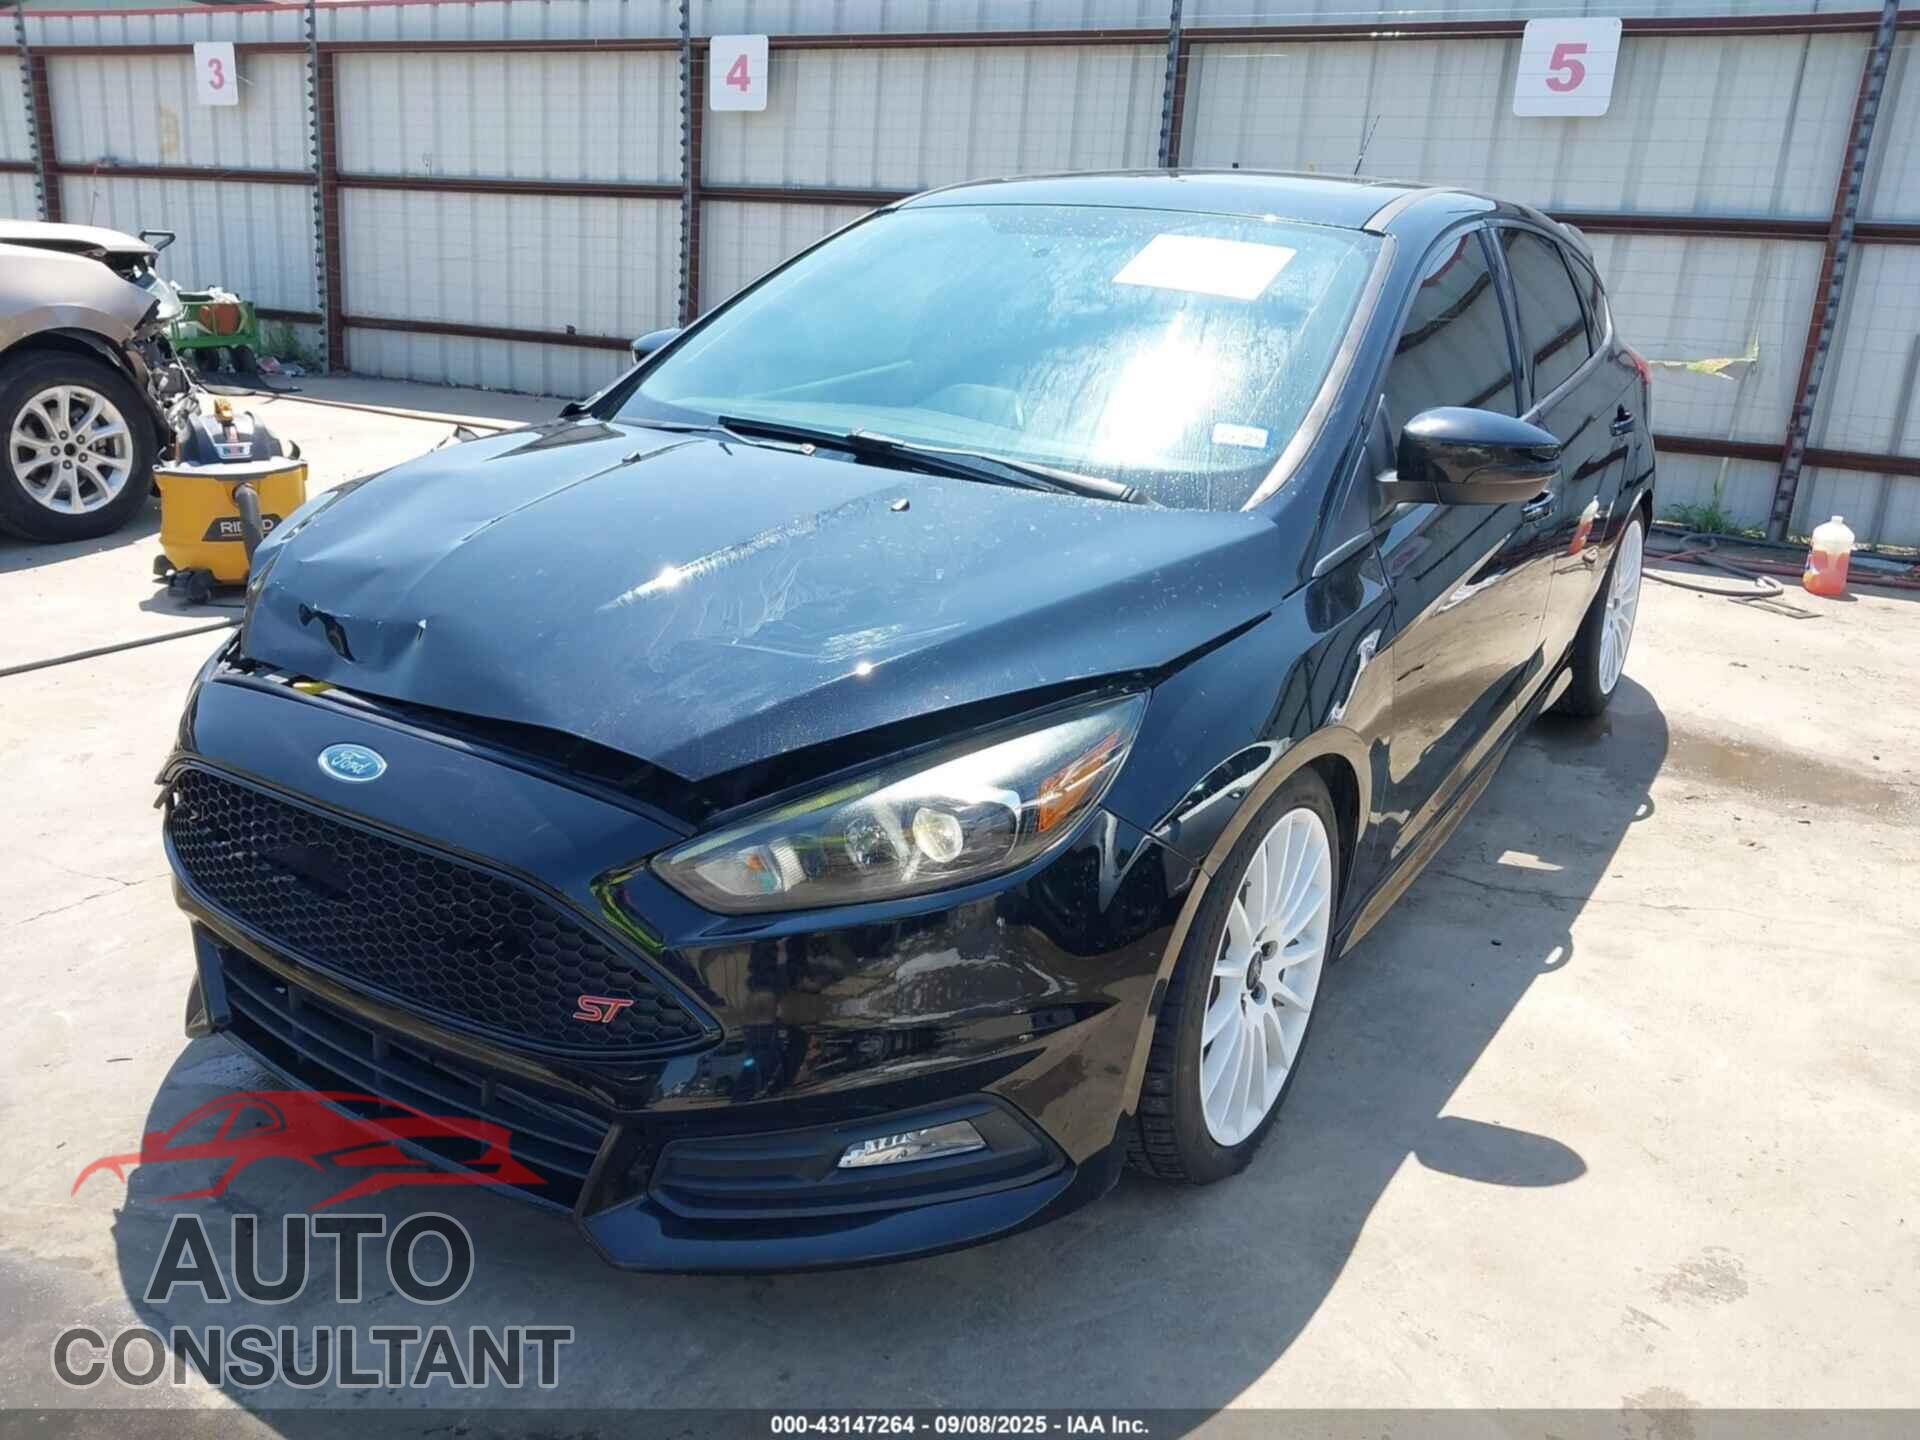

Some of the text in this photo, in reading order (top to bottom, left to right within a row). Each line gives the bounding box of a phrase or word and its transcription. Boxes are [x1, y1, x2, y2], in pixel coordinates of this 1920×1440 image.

[207, 57, 225, 90] 3
[726, 54, 752, 92] 4
[1545, 43, 1588, 92] 5
[572, 995, 635, 1023] ST
